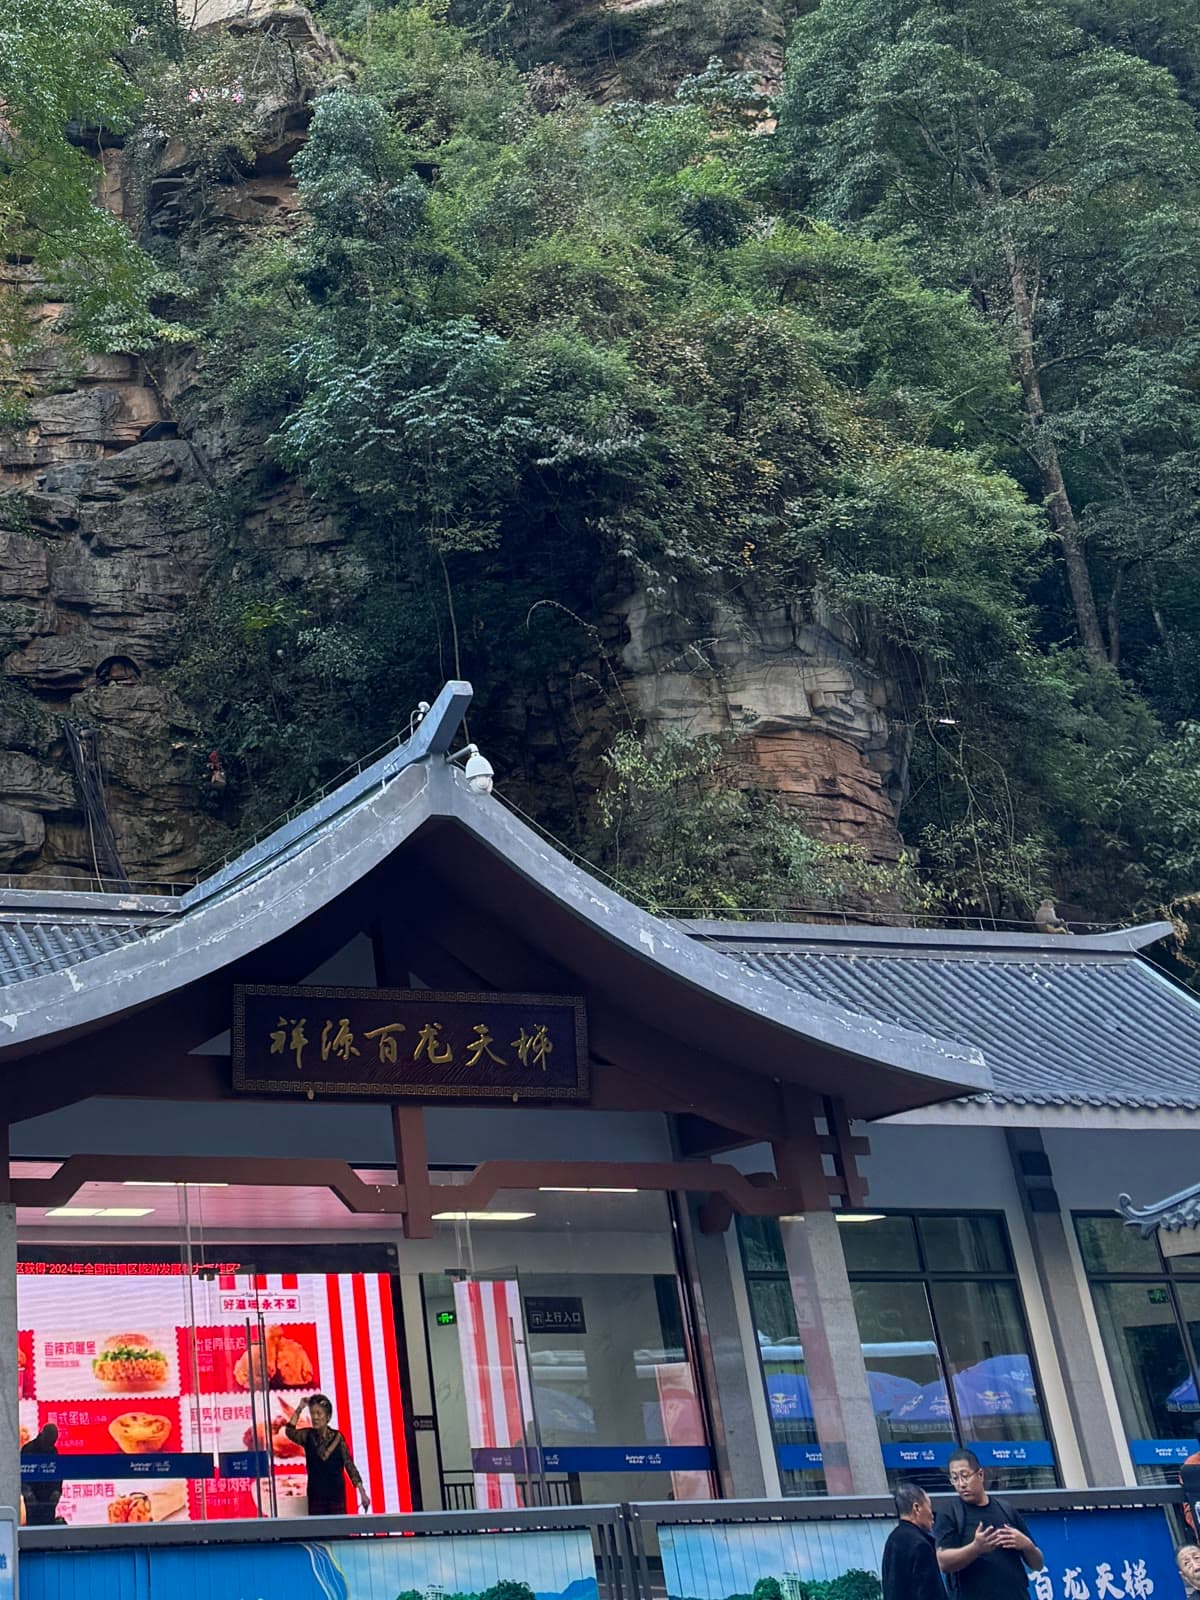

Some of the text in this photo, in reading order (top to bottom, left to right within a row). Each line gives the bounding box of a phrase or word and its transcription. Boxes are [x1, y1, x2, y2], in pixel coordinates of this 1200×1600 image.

[269, 1016, 553, 1071] 祥源百龙天梯
[545, 1311, 581, 1322] 上行入口
[1028, 1559, 1154, 1600] 百龙天梯
